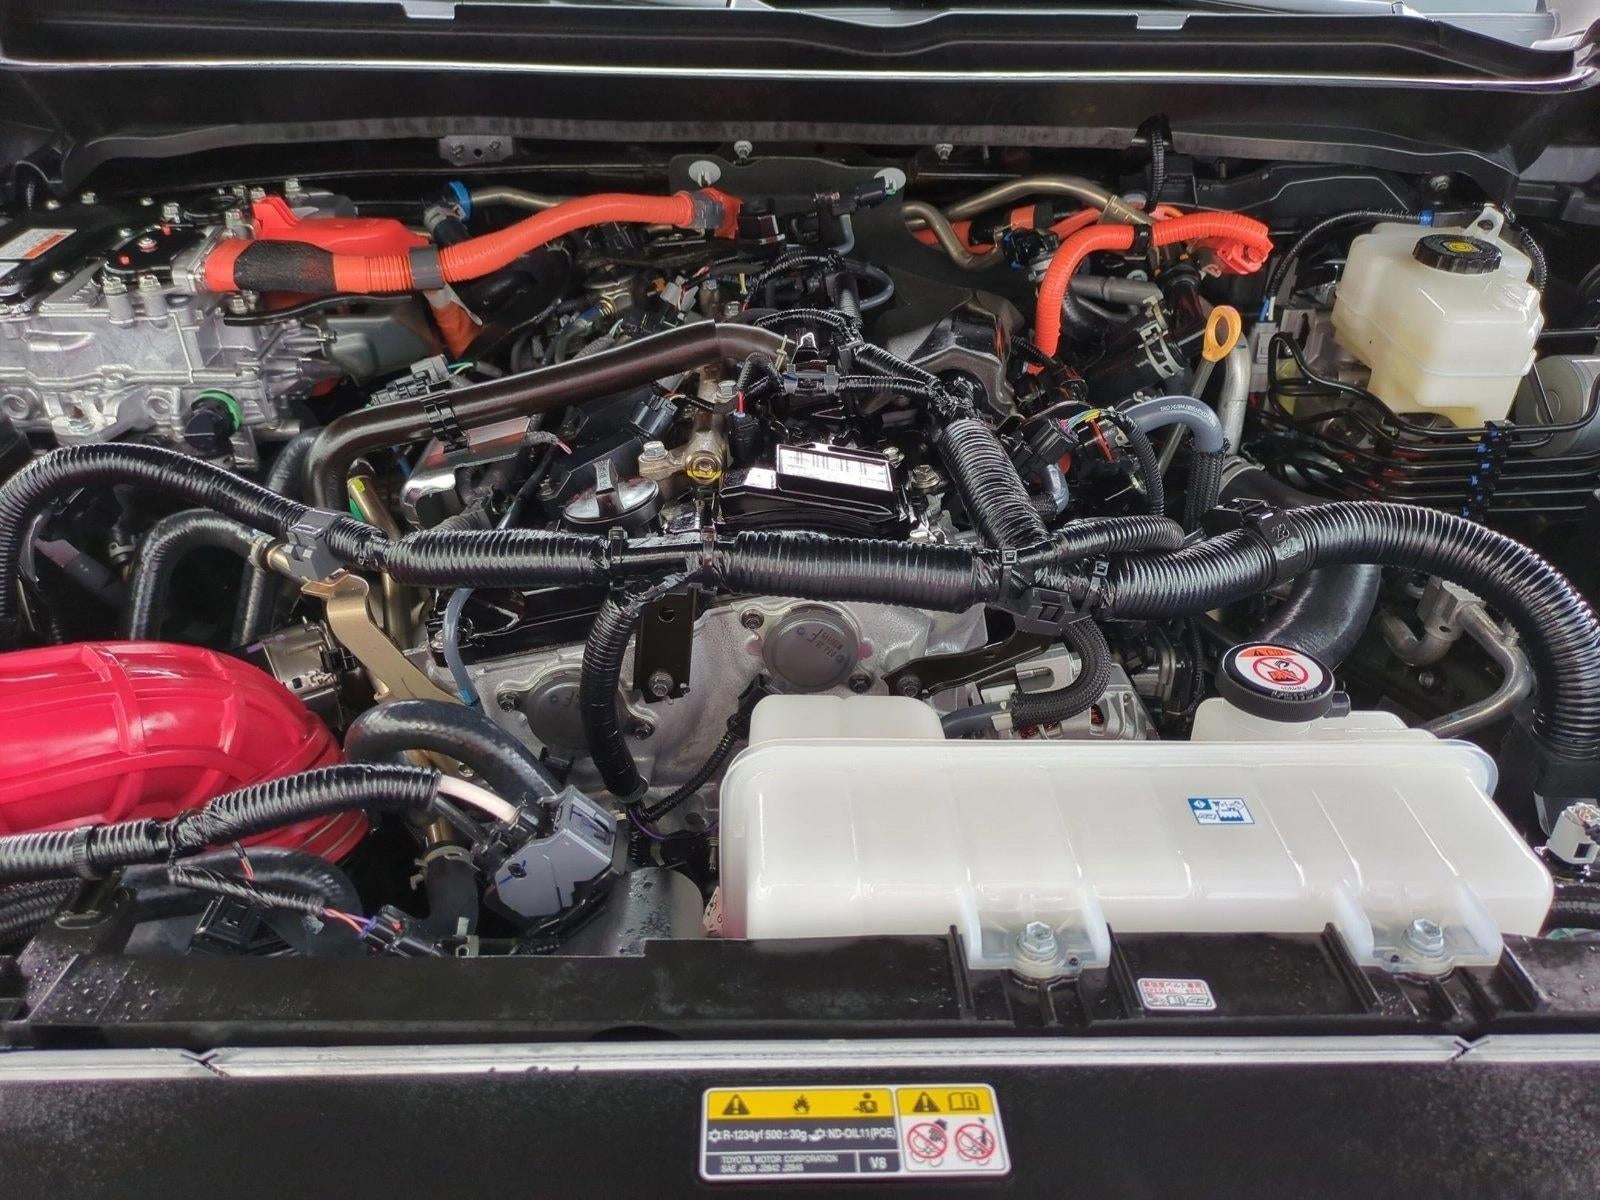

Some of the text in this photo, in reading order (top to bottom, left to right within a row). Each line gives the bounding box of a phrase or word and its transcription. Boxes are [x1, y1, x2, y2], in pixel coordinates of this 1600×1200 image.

[723, 1129, 764, 1143] R-1234yf
[765, 1128, 807, 1142] 500±30g
[721, 1154, 839, 1164] TOYOTA MOTOR CORPORATION
[721, 1164, 737, 1173] SAE
